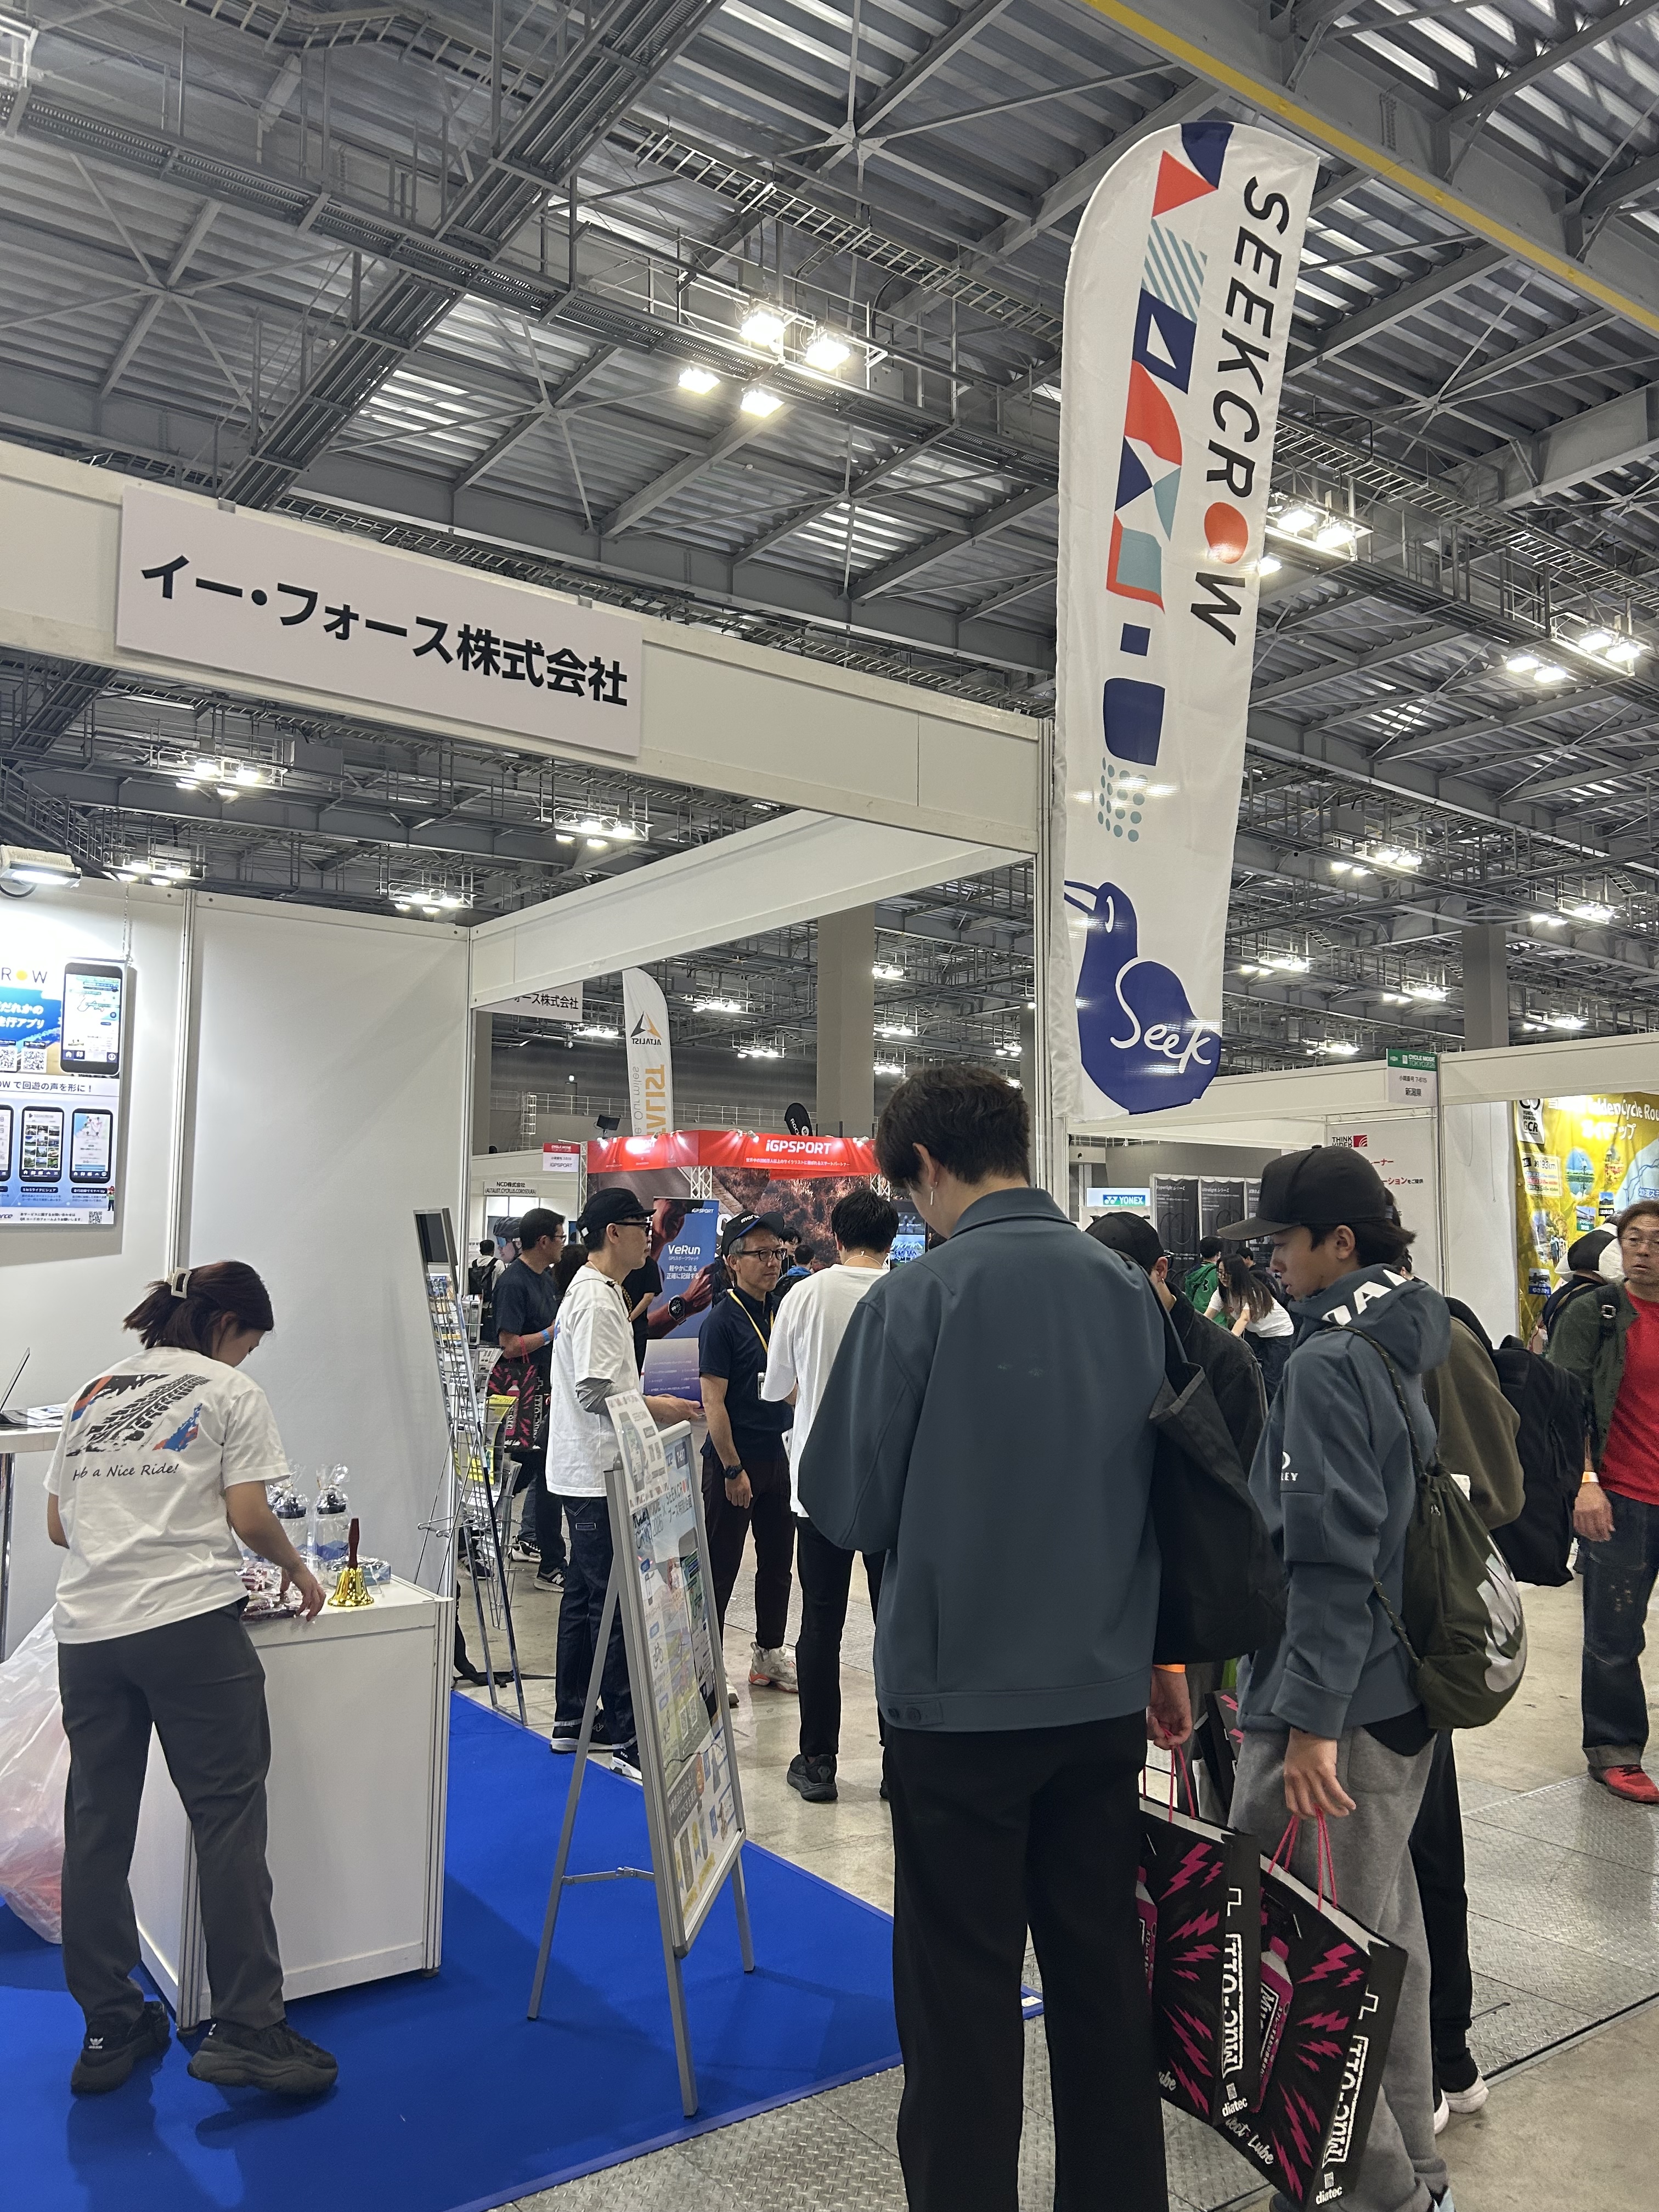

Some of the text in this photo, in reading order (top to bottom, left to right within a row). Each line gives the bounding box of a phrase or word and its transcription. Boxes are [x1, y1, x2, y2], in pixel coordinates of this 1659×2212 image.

[1190, 176, 1290, 647] SEEKCROW
[141, 555, 628, 707] イー・フォース株式会社
[1110, 968, 1212, 1074] Seek
[765, 1139, 833, 1155] iGPSPORT
[1371, 1158, 1395, 1166] ーナー
[1119, 1196, 1144, 1205] YONEX
[668, 1245, 701, 1255] VeRun
[92, 1468, 102, 1477] a
[106, 1464, 136, 1477] Nice
[140, 1463, 180, 1476] Ride!
[1222, 2098, 1248, 2117] diatec
[1247, 2134, 1274, 2165] Lube
[1316, 2186, 1343, 2205] diatec
